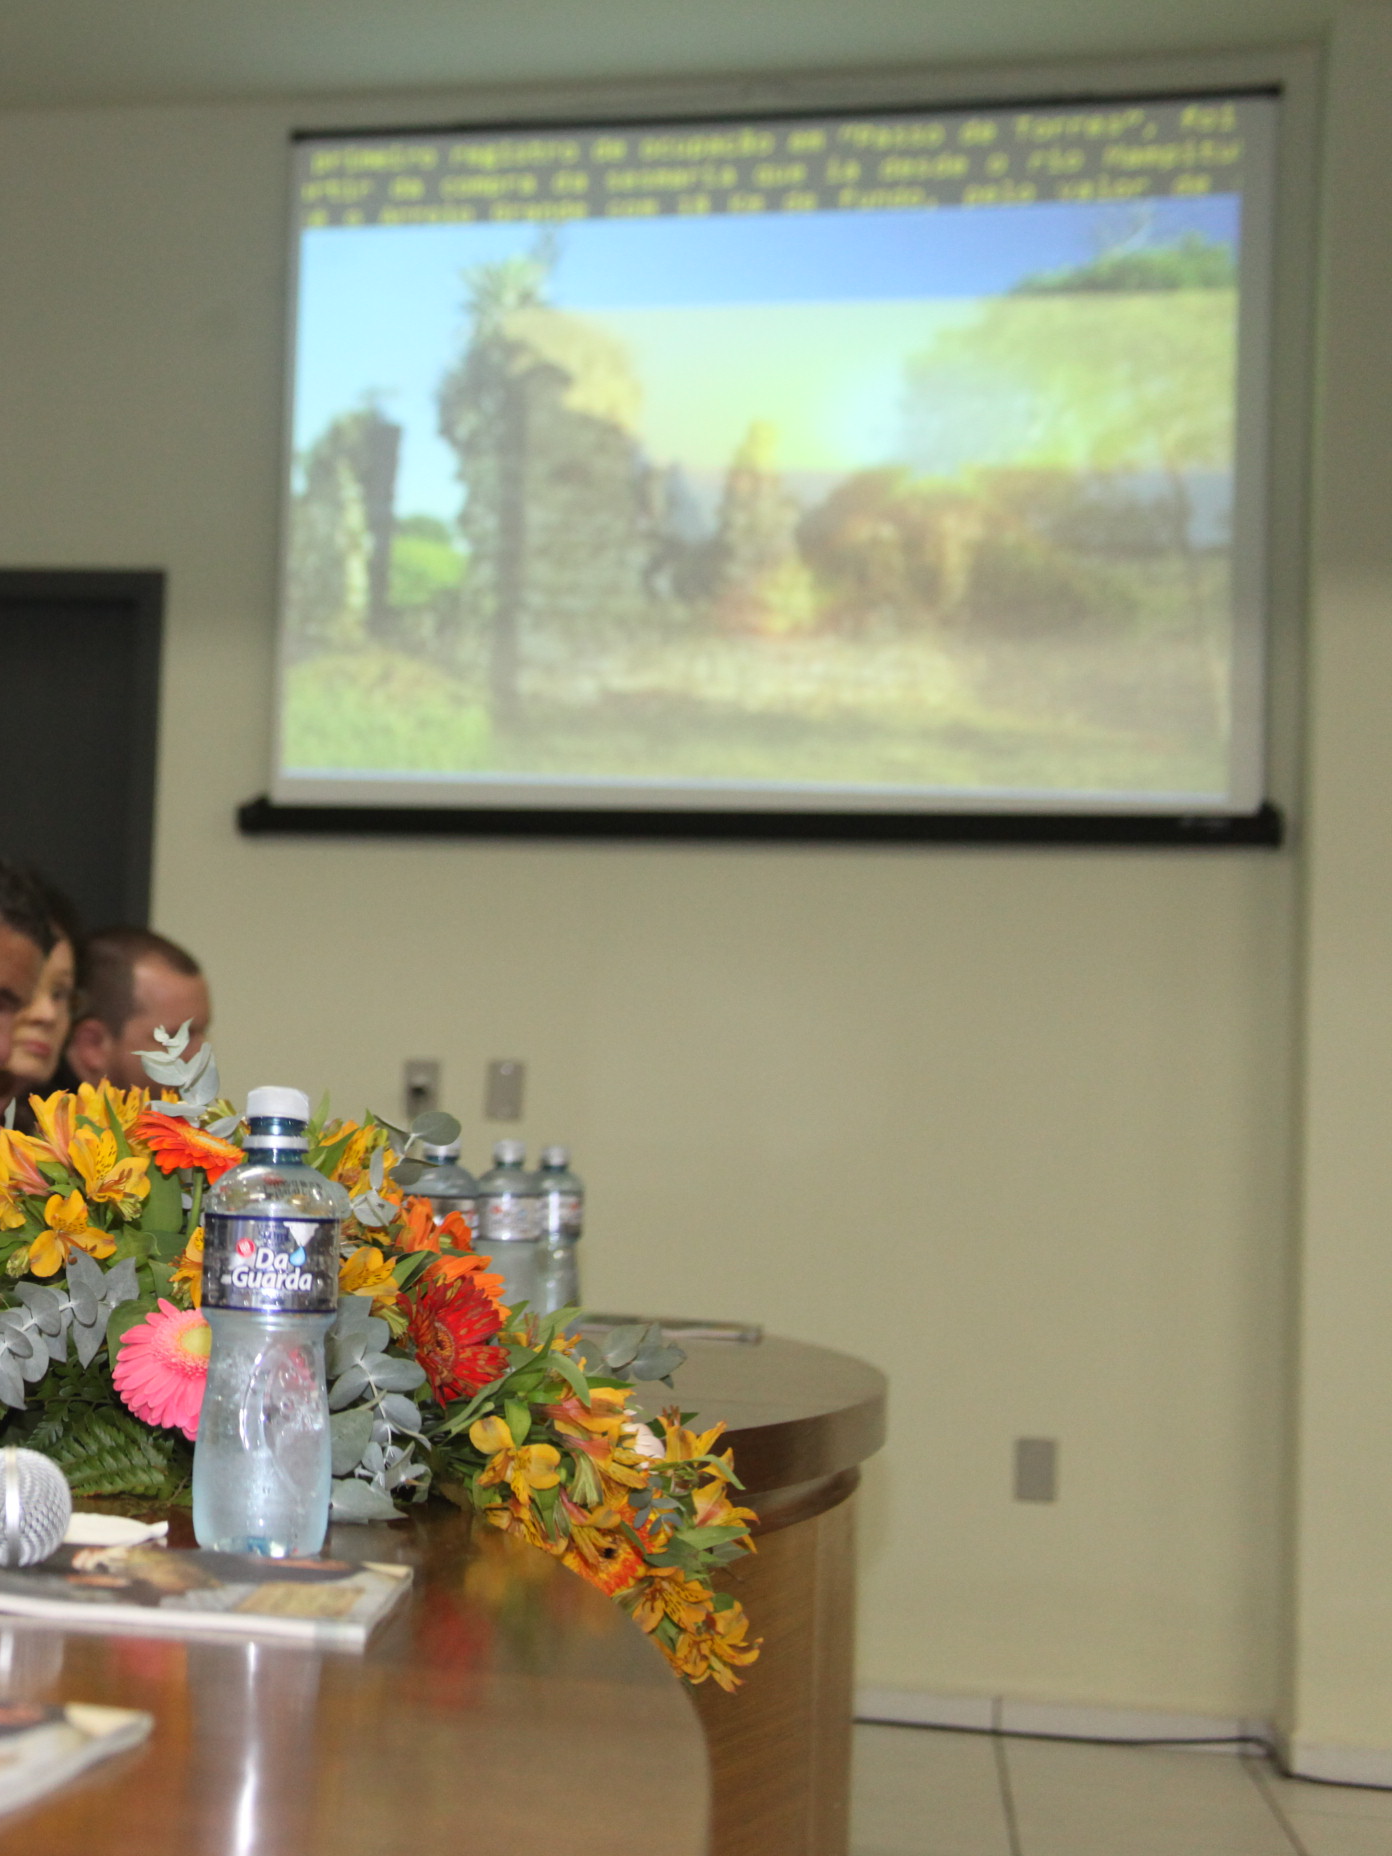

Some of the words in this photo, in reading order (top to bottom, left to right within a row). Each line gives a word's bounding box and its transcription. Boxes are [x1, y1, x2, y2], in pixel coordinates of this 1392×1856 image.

[591, 135, 627, 161] de
[788, 130, 826, 152] em
[960, 118, 998, 144] de
[1179, 106, 1236, 134] foi
[389, 175, 423, 200] da
[551, 169, 587, 193] da
[755, 162, 810, 189] que
[988, 153, 1010, 174] o
[1027, 146, 1085, 172] rio
[255, 1247, 289, 1270] Da
[231, 1266, 313, 1292] Guarda
